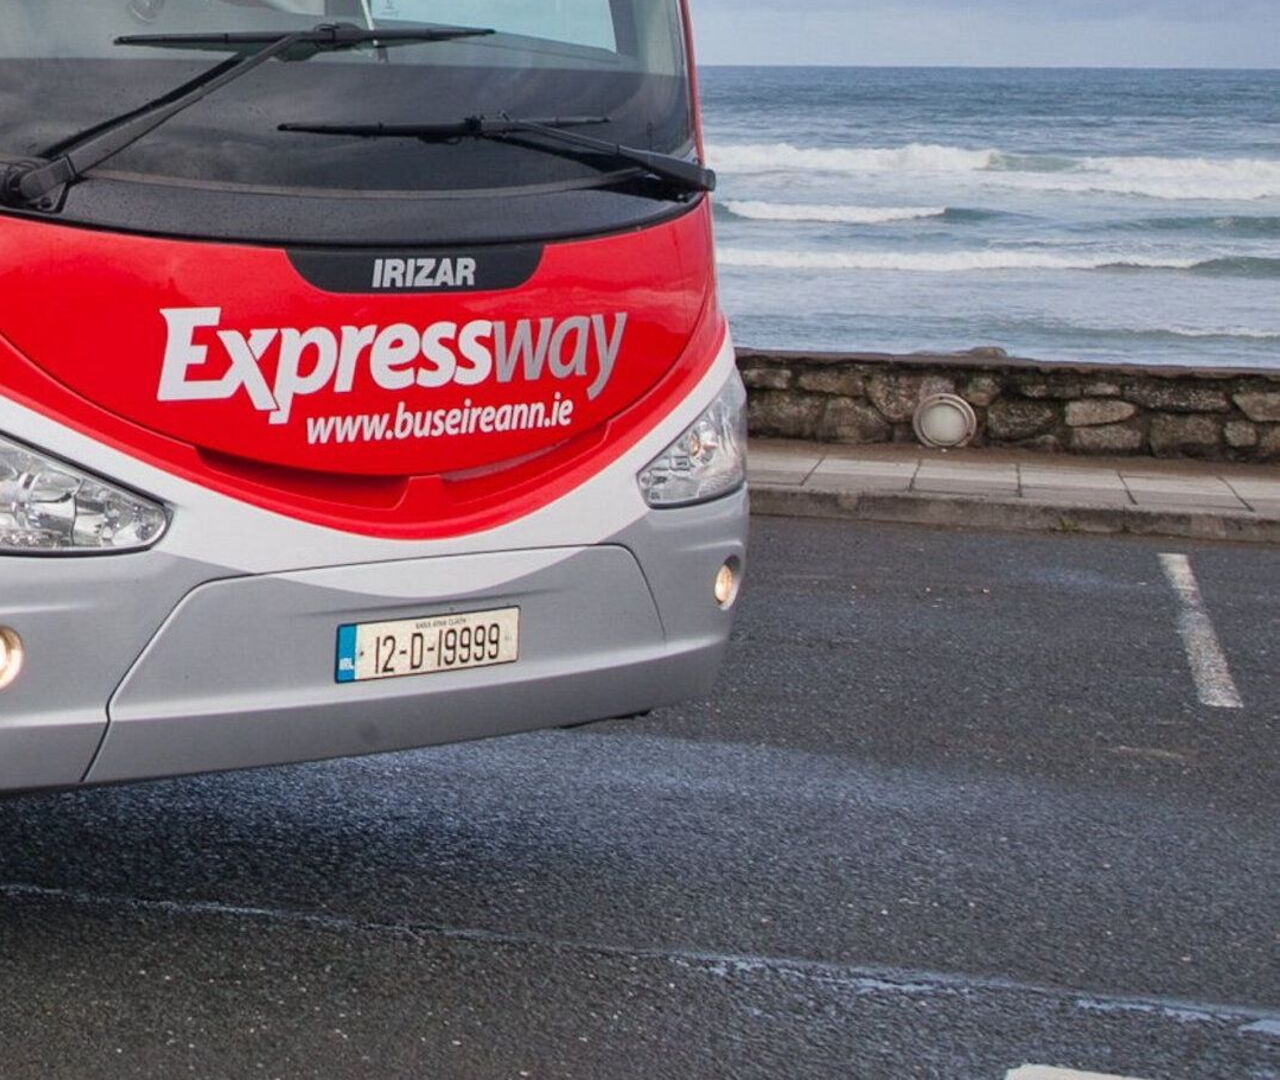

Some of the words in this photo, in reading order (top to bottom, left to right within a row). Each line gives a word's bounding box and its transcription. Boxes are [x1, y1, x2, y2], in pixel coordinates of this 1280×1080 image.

[371, 257, 477, 289] IRIZAR
[156, 305, 627, 425] Expressway
[306, 392, 574, 445] www.buseireann.ie
[374, 622, 501, 674] 12-D-19999
